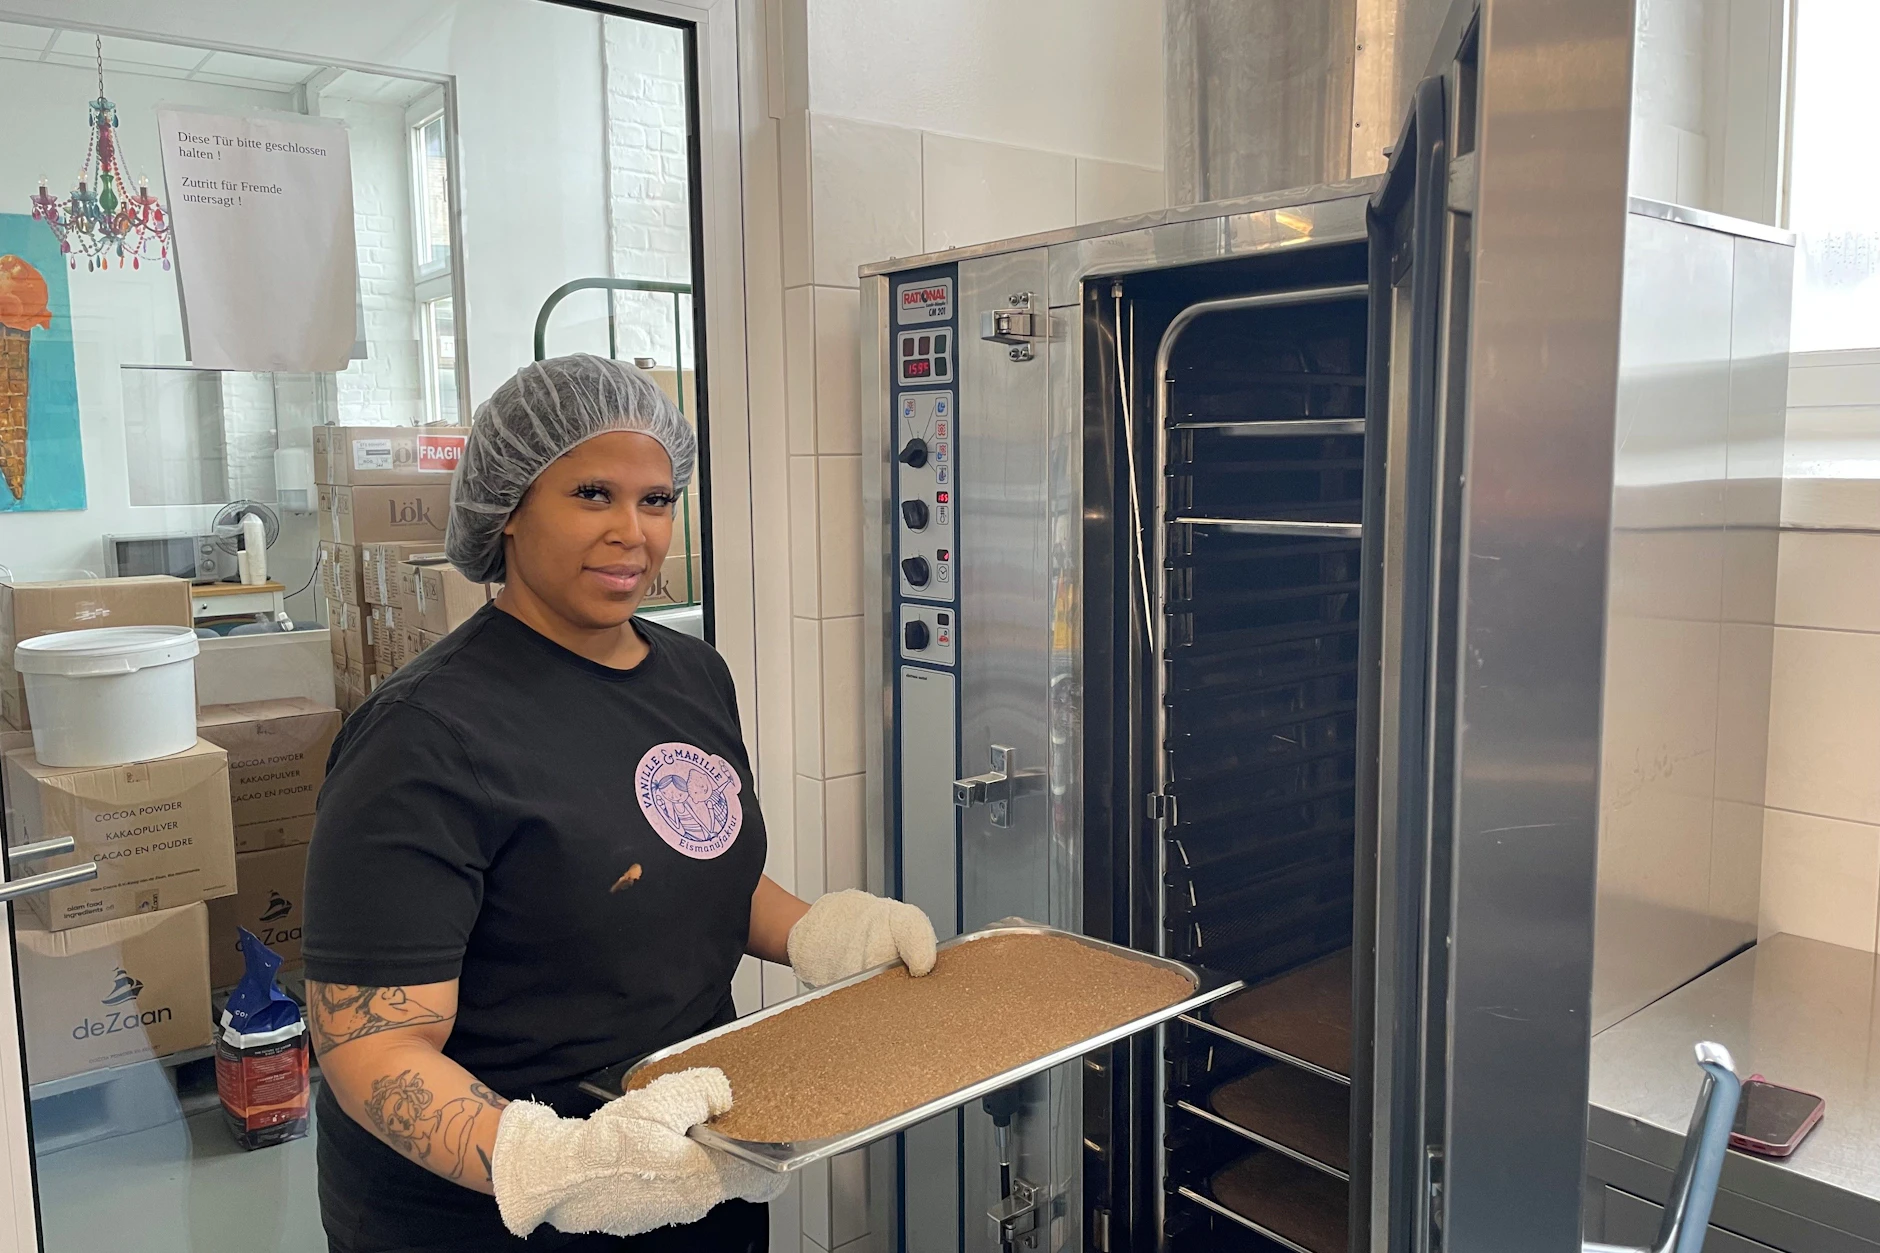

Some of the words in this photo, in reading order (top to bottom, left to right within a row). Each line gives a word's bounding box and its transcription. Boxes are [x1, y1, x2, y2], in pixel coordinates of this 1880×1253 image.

[178, 131, 210, 145] Diese
[213, 135, 234, 147] Tür
[237, 136, 262, 149] bitte
[265, 141, 327, 156] geschlossen
[179, 146, 214, 160] halten
[181, 176, 218, 190] Zutritt
[221, 180, 238, 191] für
[241, 181, 283, 194] Fremde
[183, 193, 235, 207] untersagt
[903, 288, 946, 305] RATIONAL
[231, 758, 265, 769] COCOA
[268, 752, 304, 764] POWDER
[240, 769, 301, 785] KAKAOPULVER
[641, 755, 661, 809] VANILLE
[660, 748, 675, 765] &
[674, 749, 723, 782] MARILLE
[264, 789, 276, 798] EN
[279, 784, 313, 795] POUDRE
[95, 808, 137, 823] COCOA
[139, 801, 183, 816] POWDER
[106, 821, 179, 841] KAKAOPULVER
[678, 814, 737, 853] Eismanufaktur
[93, 848, 132, 862] CACAO
[135, 846, 149, 855] EN
[152, 837, 193, 852] POUDRE
[63, 907, 104, 919] ingredients
[67, 904, 86, 912] olam
[86, 900, 103, 908] food
[72, 1007, 172, 1040] deZaan
